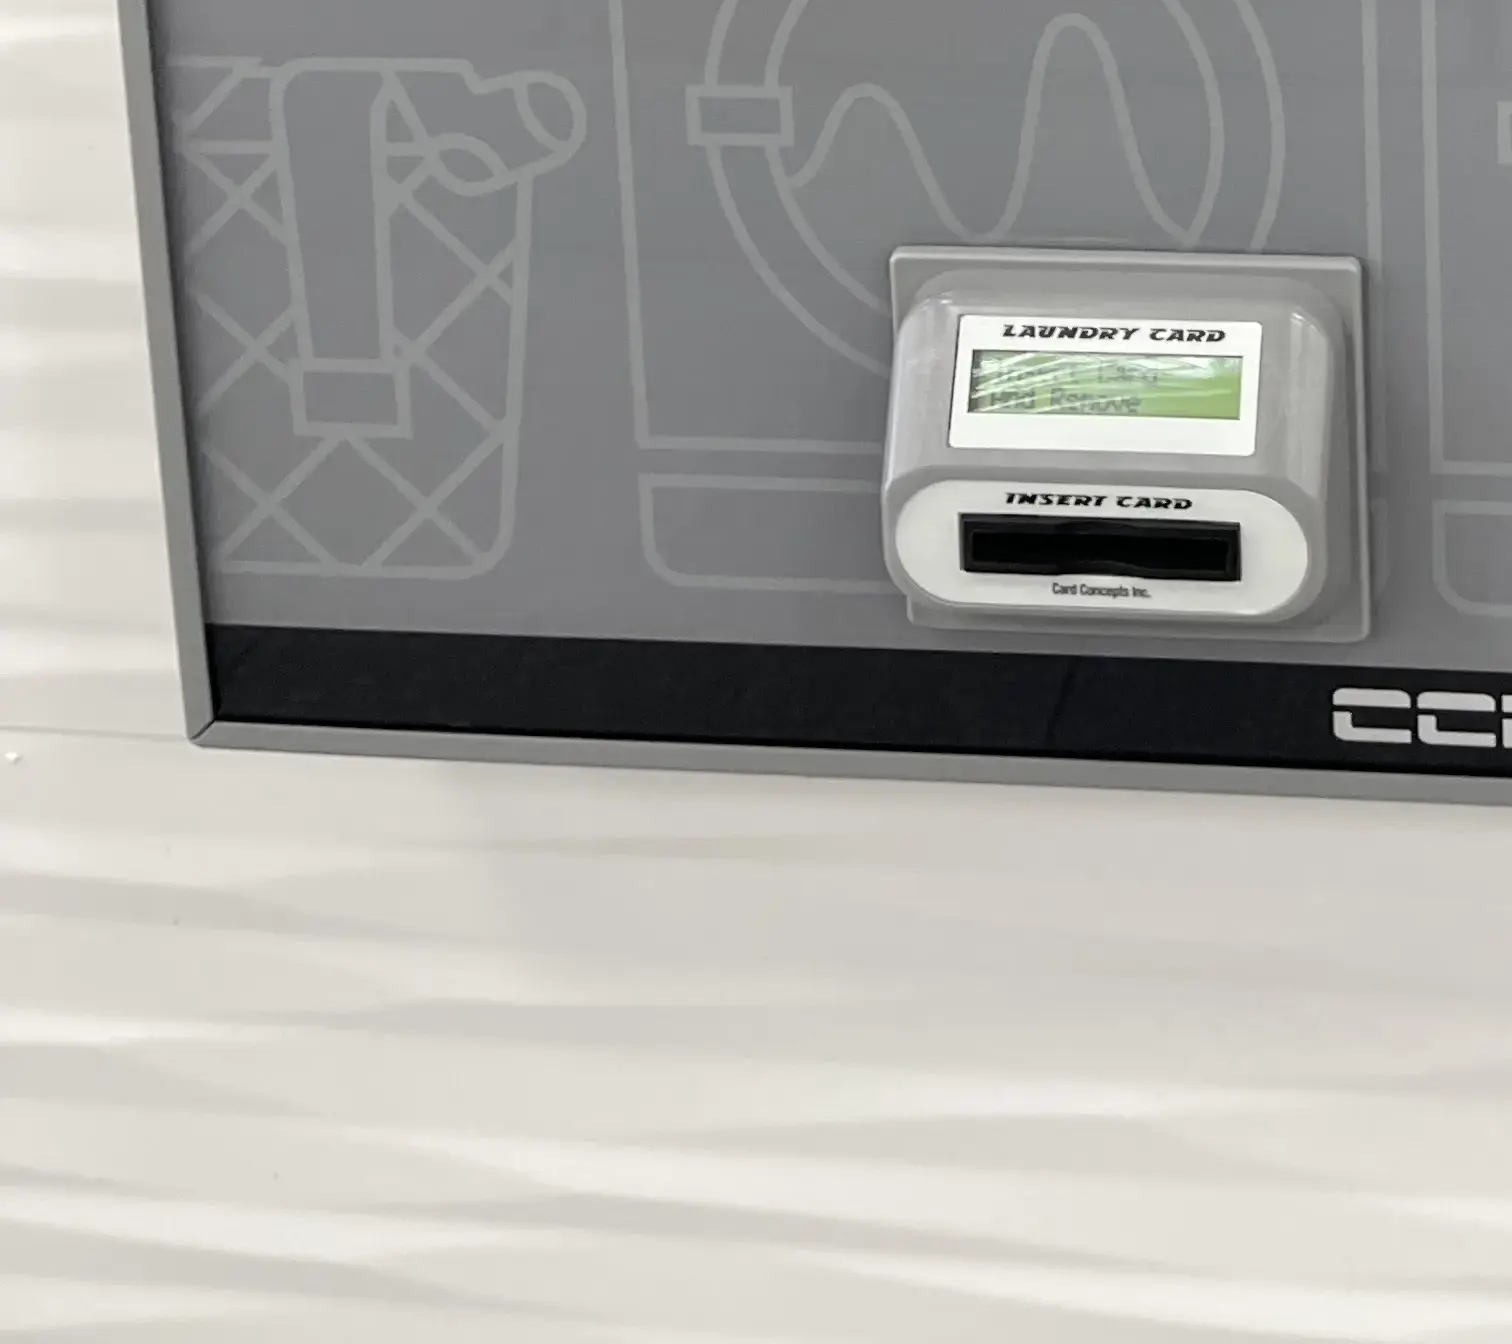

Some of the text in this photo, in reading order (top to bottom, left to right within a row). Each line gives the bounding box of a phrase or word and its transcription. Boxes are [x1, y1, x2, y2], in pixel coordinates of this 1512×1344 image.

[1002, 324, 1226, 343] LAUNDRY CARD
[1004, 492, 1193, 511] INSERT CARD
[1052, 582, 1152, 601] Card Concepts Inc.
